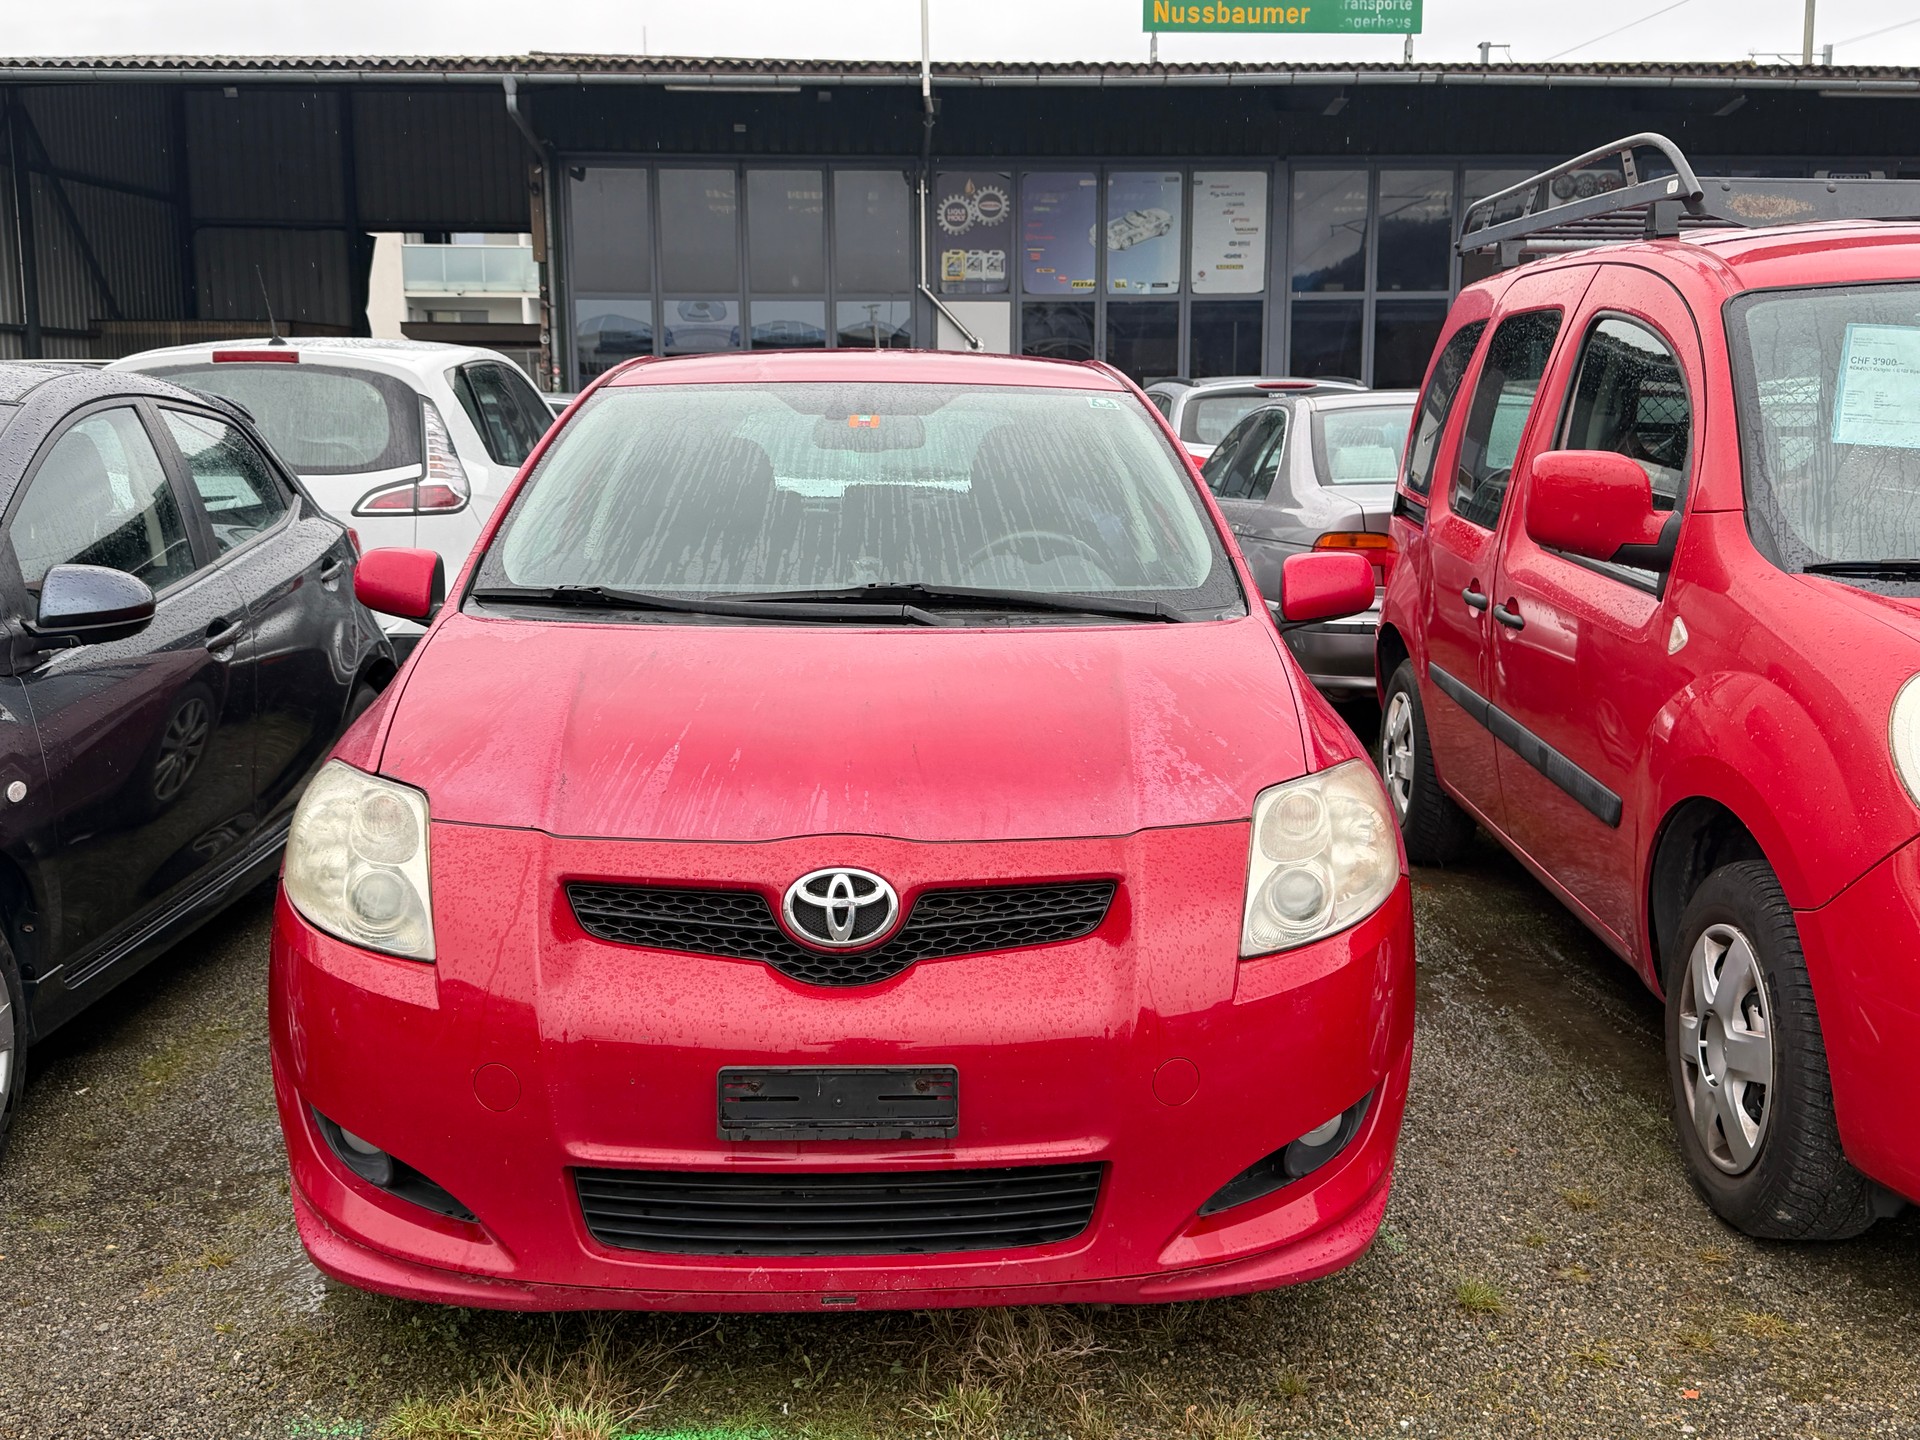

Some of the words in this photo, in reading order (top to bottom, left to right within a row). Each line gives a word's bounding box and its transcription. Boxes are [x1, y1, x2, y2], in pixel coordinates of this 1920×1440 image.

[1153, 0, 1311, 24] Nussbaumer
[1340, 0, 1413, 14] ransporte
[1850, 356, 1871, 365] CHF
